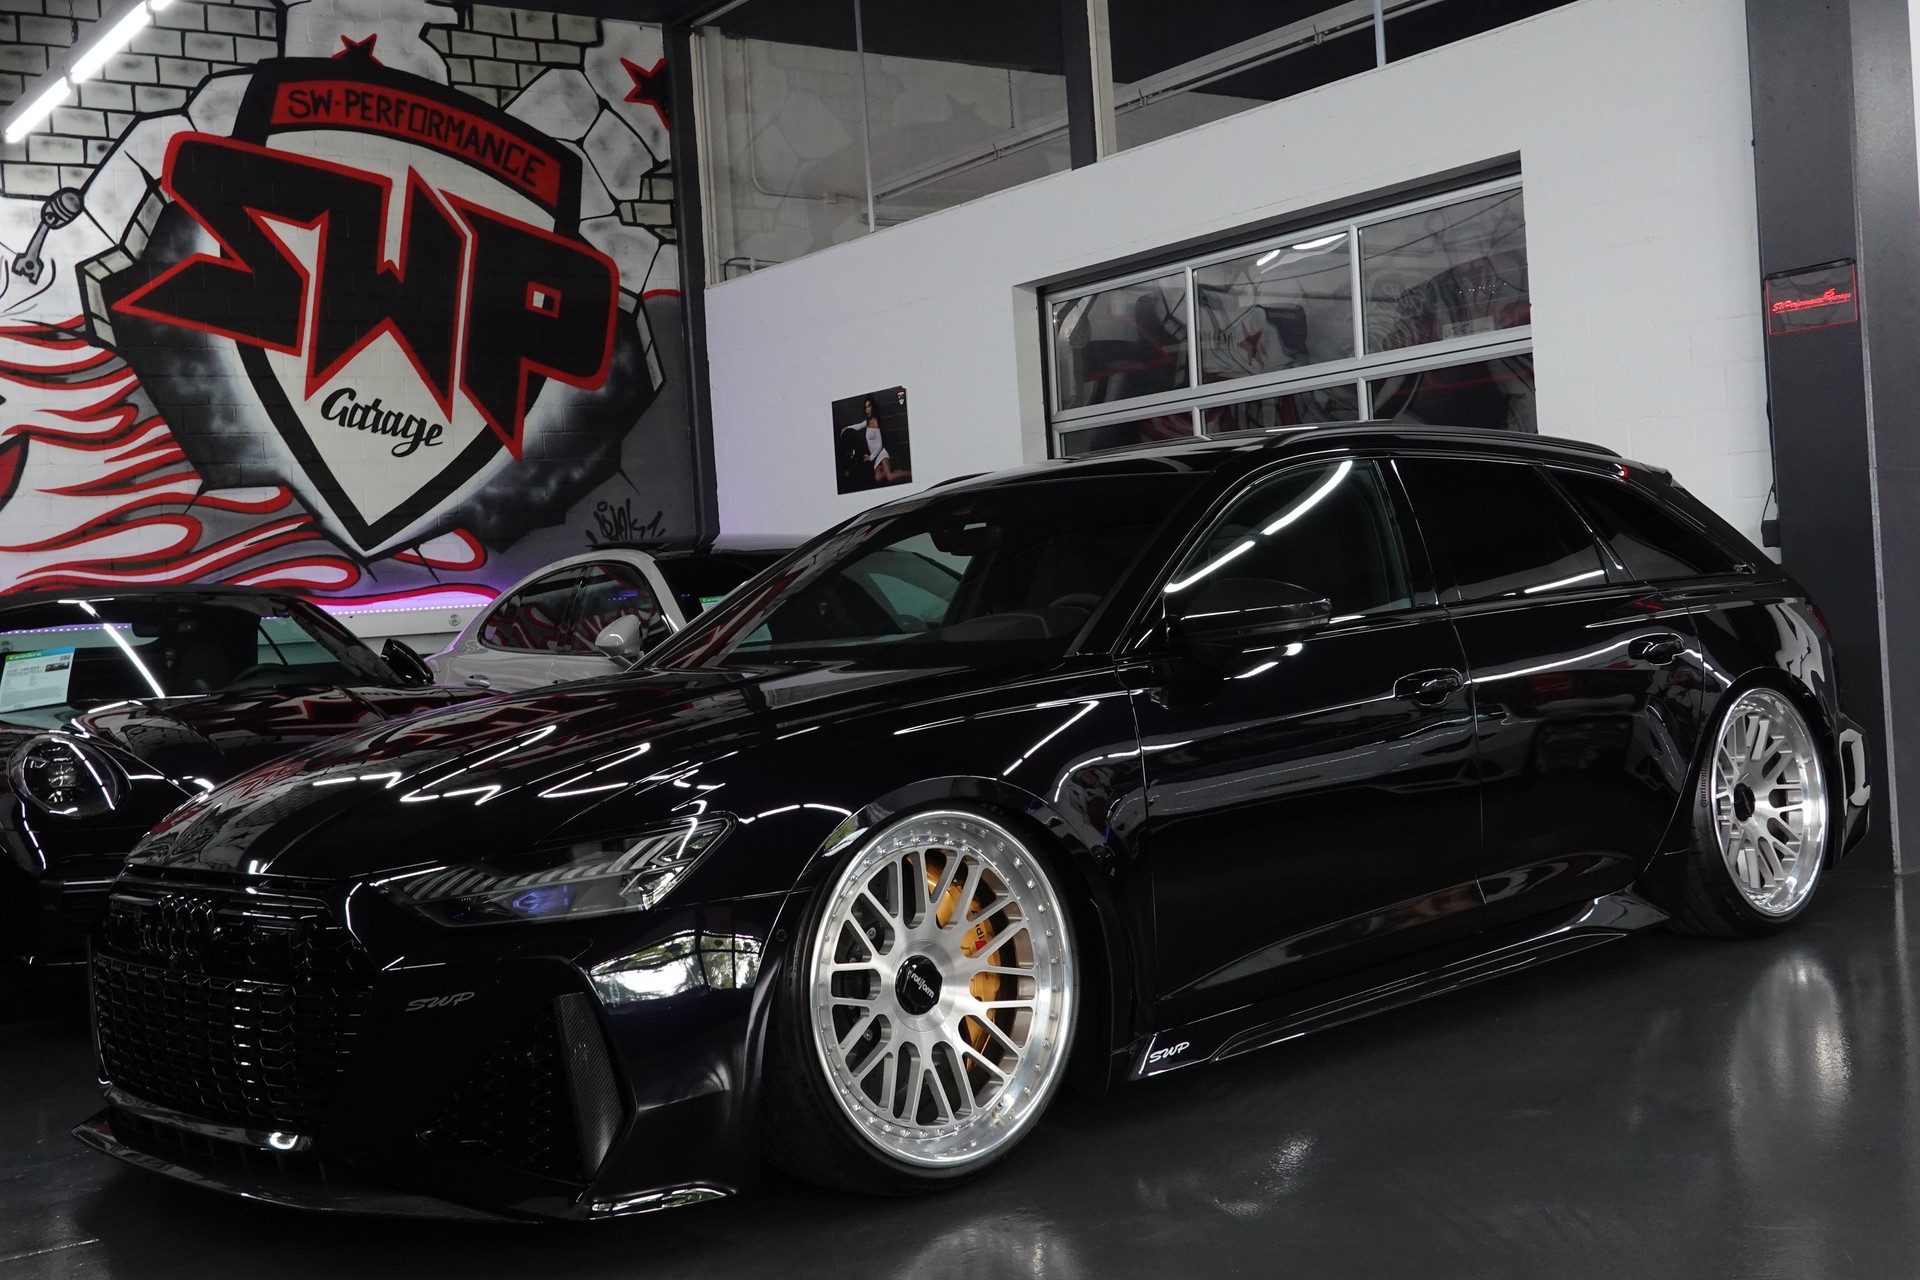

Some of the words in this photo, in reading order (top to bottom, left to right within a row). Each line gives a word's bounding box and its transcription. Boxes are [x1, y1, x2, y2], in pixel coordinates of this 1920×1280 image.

[288, 89, 546, 188] SW-PERFORMANCE
[111, 131, 620, 463] SWP
[320, 387, 444, 458] Garage
[405, 991, 475, 1012] SWP
[911, 972, 935, 999] rotiform
[1149, 1041, 1190, 1064] SWP
